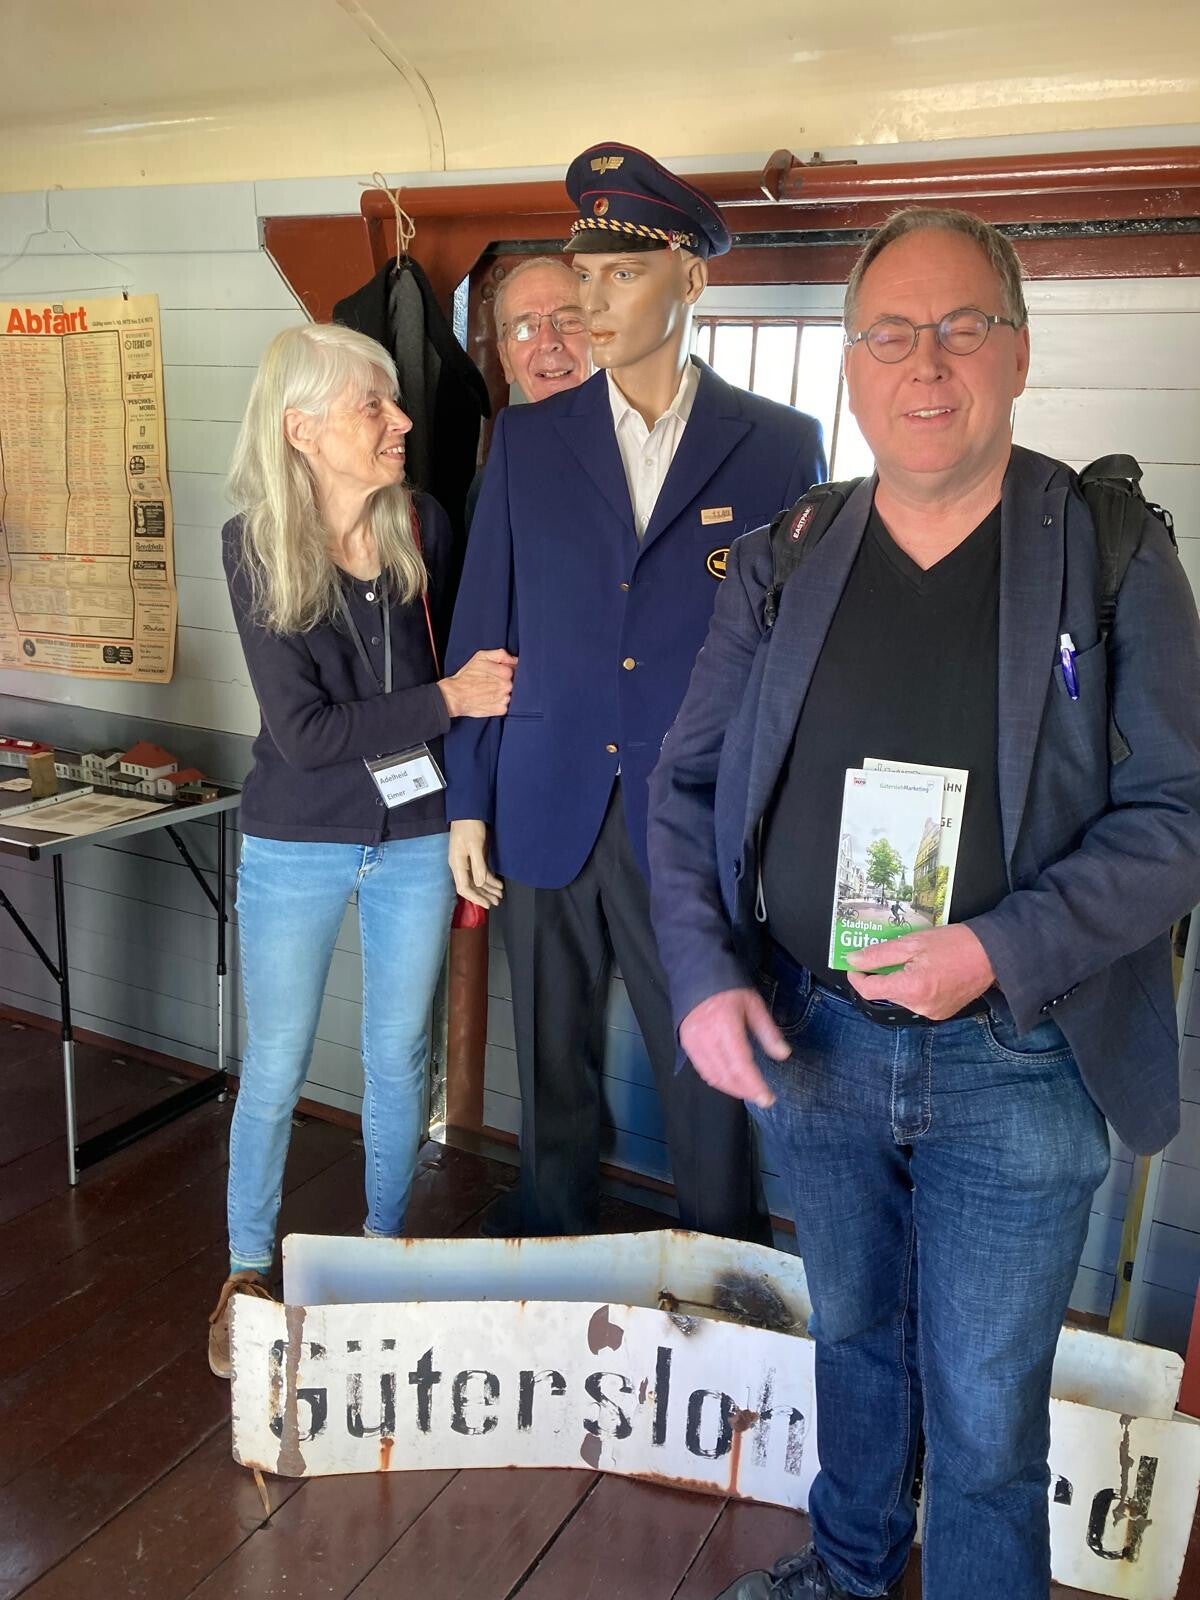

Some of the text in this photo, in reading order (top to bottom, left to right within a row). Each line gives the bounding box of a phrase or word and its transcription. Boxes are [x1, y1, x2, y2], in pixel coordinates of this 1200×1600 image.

[793, 506, 811, 539] EASTPAK
[380, 770, 408, 784] Adelheid
[841, 918, 883, 932] Stadtplan
[268, 1338, 806, 1476] Gütersloh
